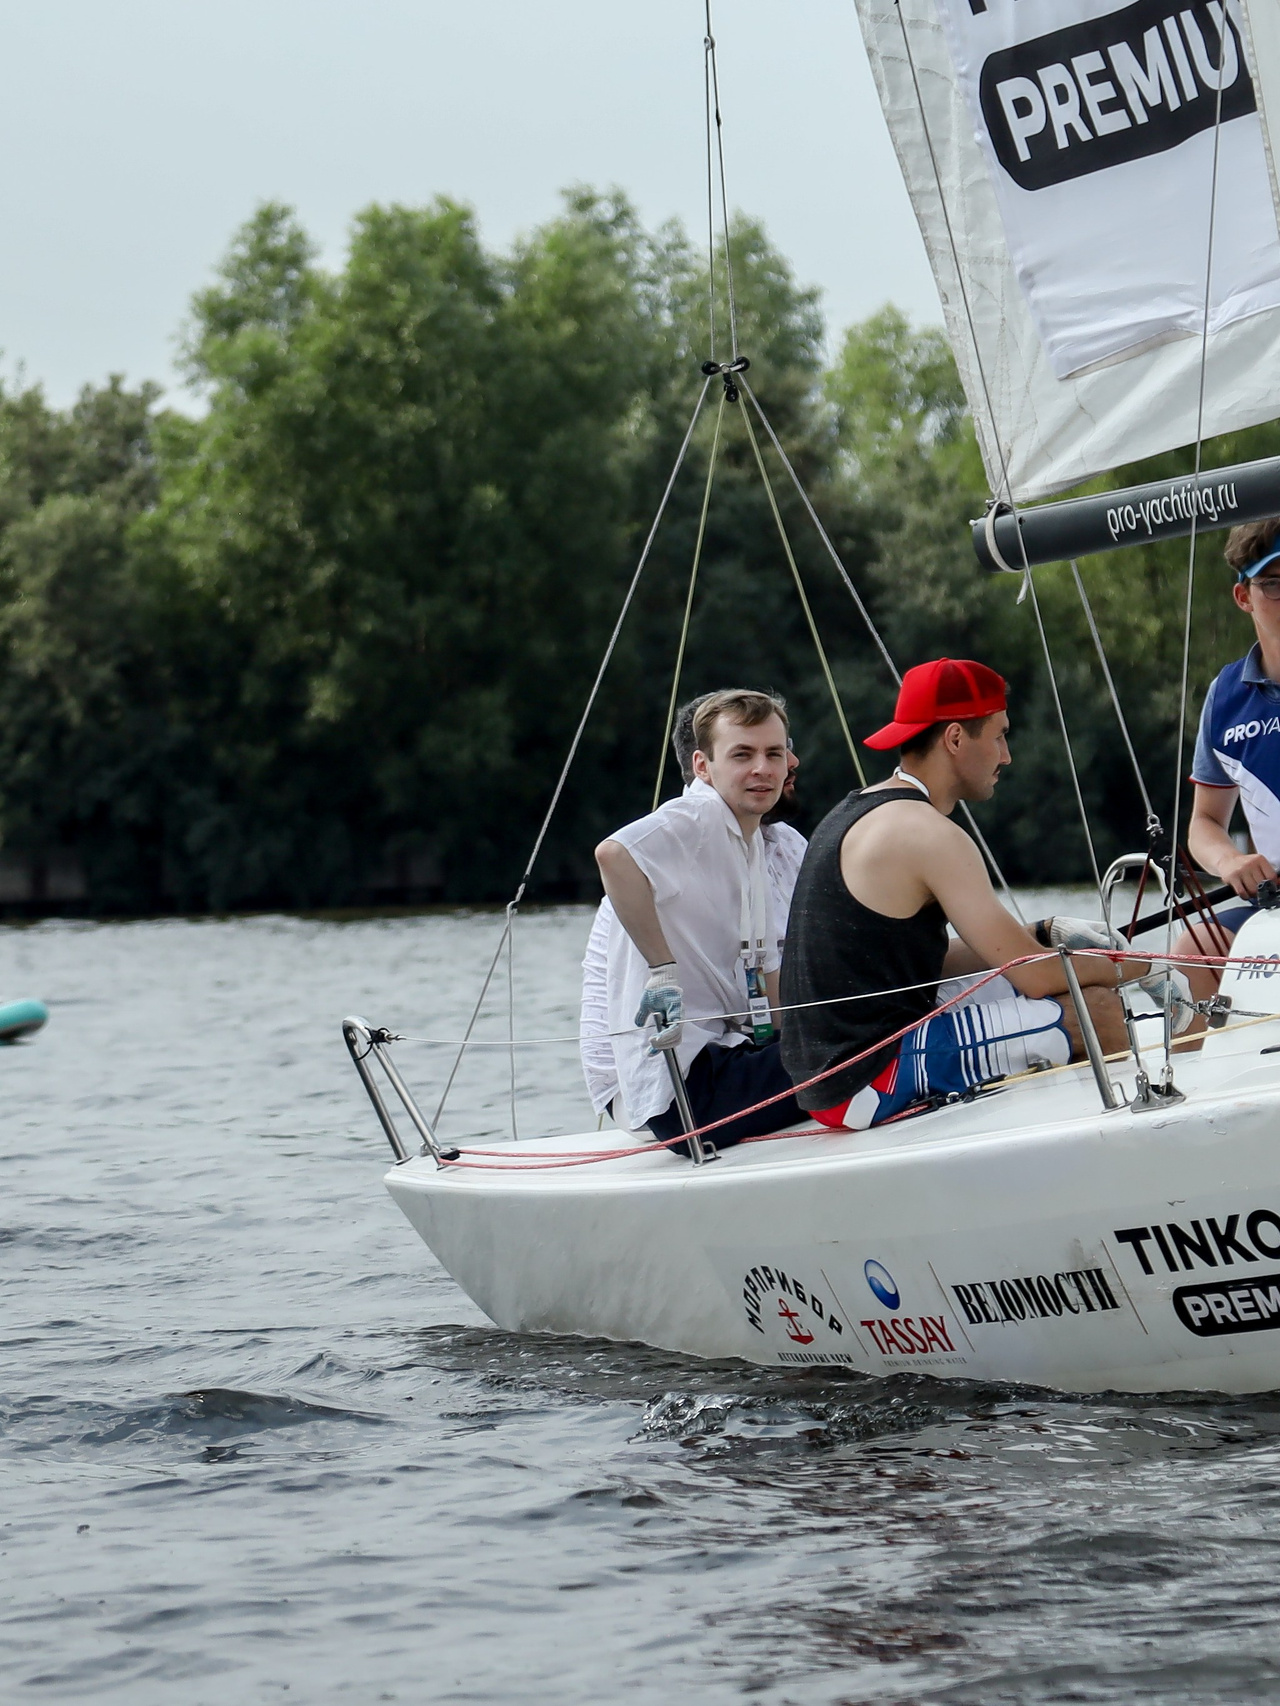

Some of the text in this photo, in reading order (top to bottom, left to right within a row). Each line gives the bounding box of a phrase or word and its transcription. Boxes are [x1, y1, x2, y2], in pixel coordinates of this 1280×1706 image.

[1106, 483, 1239, 542] pro-yachting.ru
[743, 1265, 844, 1335] МОРПРИБОР
[951, 1268, 1122, 1328] ВЕДОМОСТИ
[860, 1315, 957, 1355] TASSAY
